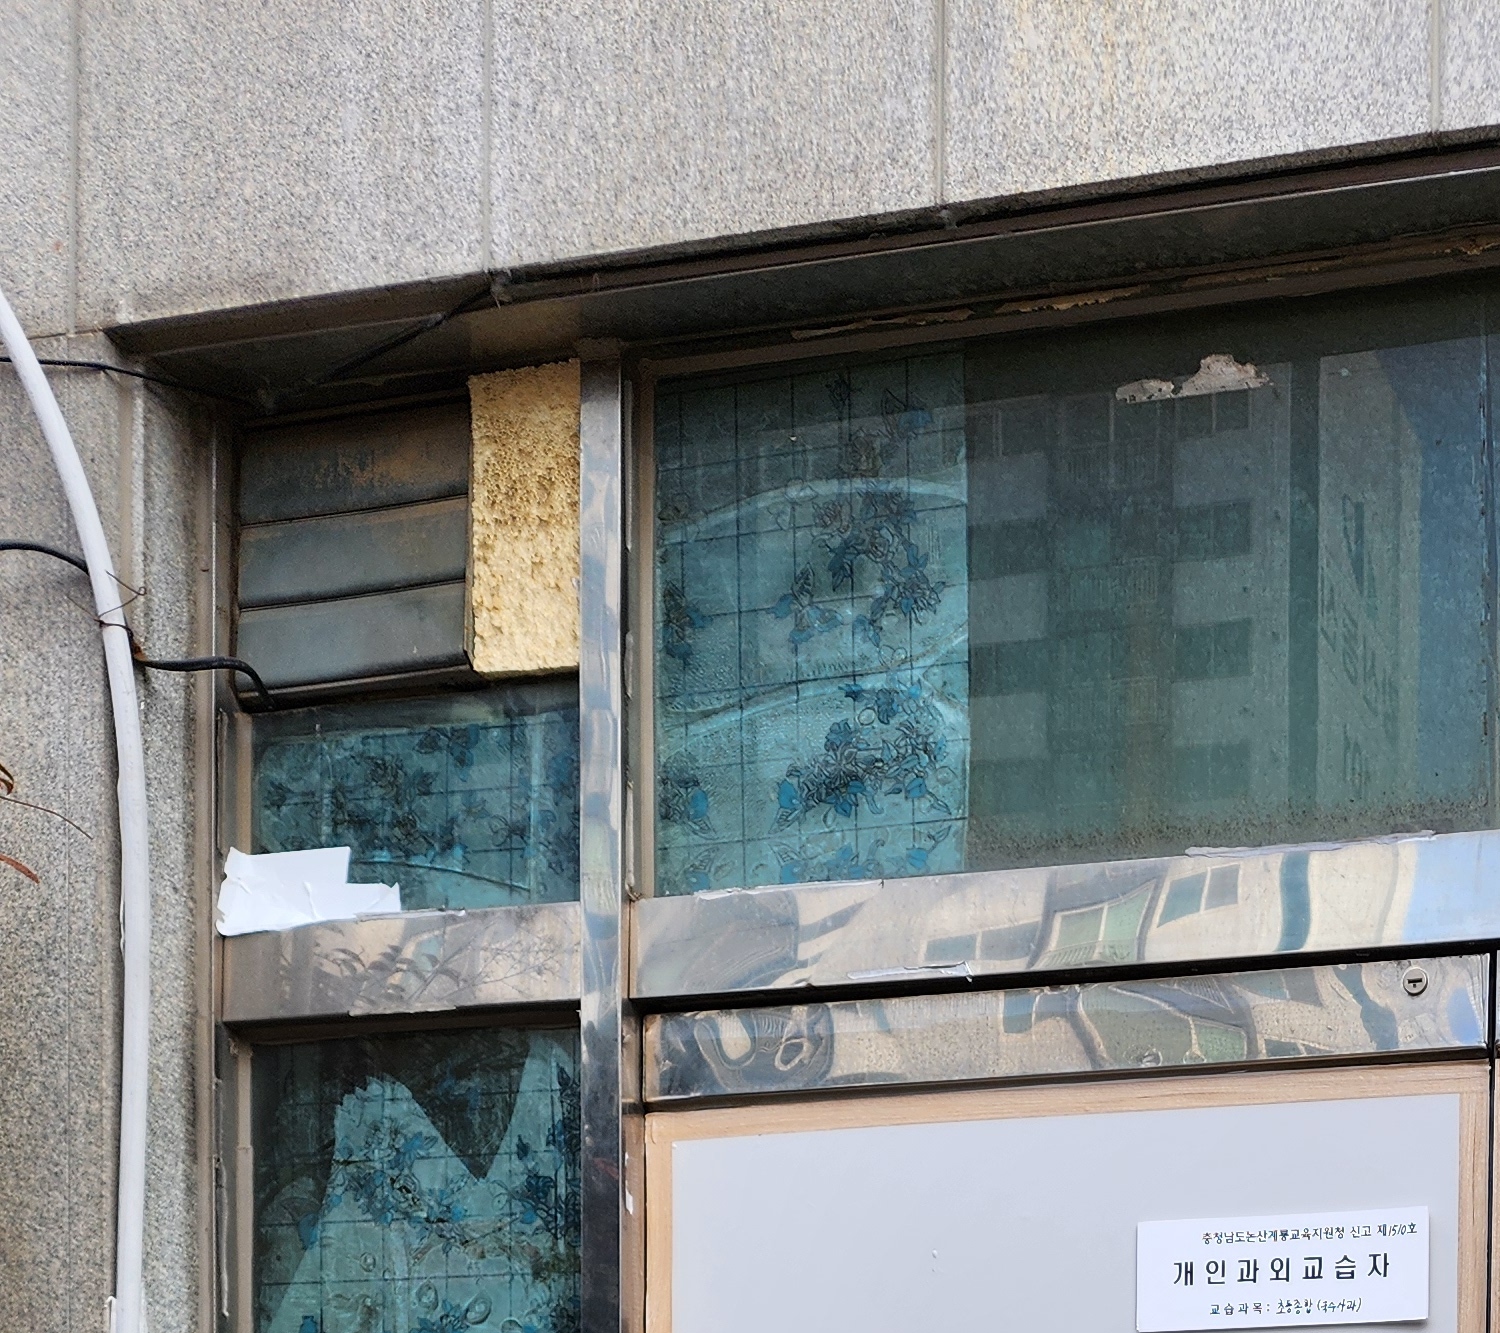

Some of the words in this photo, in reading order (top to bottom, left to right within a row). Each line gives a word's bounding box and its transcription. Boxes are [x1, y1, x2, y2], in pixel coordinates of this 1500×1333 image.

[1201, 1226, 1346, 1246] 충청남도논산계룡교육지원청
[1349, 1225, 1372, 1239] 신고
[1173, 1252, 1390, 1286] 개인과외교습자
